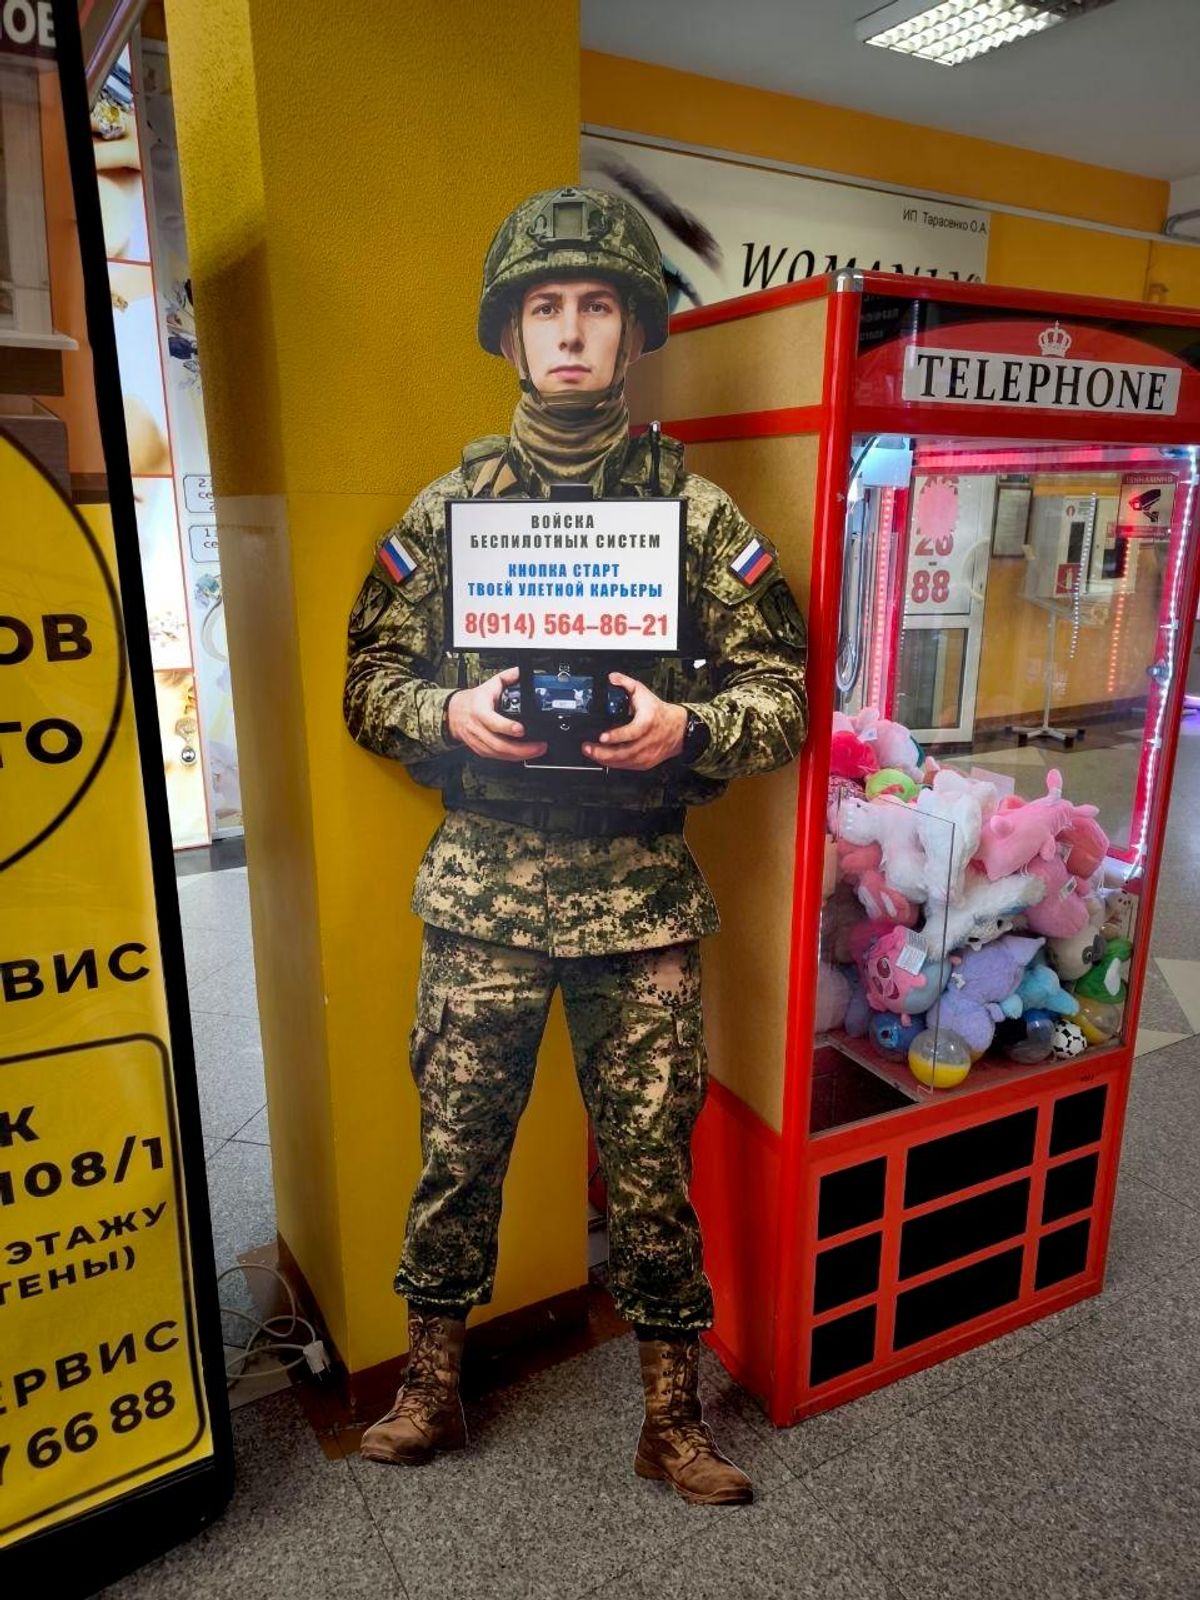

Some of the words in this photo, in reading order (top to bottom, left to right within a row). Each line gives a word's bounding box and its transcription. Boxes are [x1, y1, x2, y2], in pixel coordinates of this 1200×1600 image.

[917, 354, 1168, 410] TELEPHONE
[531, 513, 594, 529] ВОЙСКА
[470, 535, 589, 549] БЕСПИЛОТНЫХ
[596, 534, 661, 549] СИСТЕМ
[508, 563, 568, 578] КНОПКА
[573, 563, 620, 578] СТАРТ
[468, 581, 513, 597] ТВОЕЙ
[518, 581, 584, 598] УЛЕТНОЙ
[590, 584, 663, 598] КАРЬЕРЫ
[464, 612, 536, 639] 8(914)
[6, 1201, 167, 1266] ЭТАЖУ
[0, 1319, 180, 1415] РВИС
